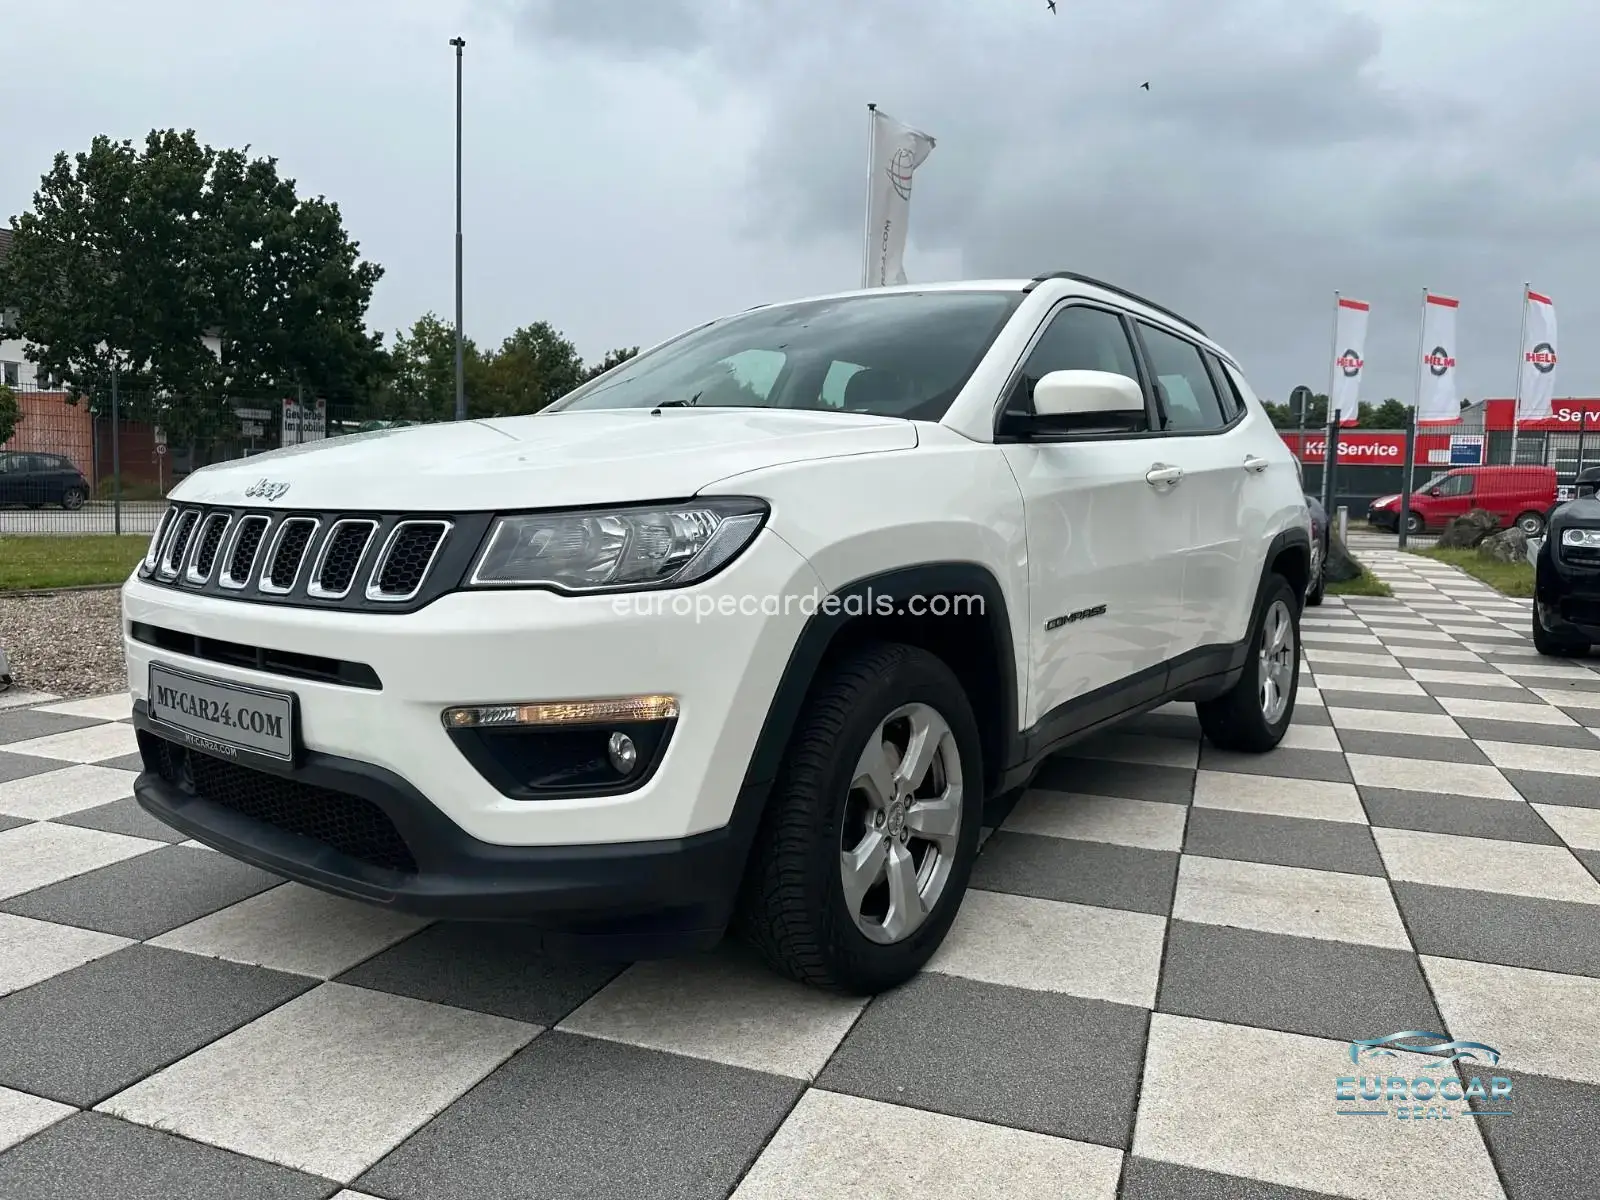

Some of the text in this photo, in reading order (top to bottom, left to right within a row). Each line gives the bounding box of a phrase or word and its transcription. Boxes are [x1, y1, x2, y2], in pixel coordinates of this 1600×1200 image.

[1424, 355, 1456, 368] HELM
[1305, 441, 1398, 456] Kf Service
[244, 477, 291, 502] Jeep
[1044, 604, 1107, 631] COMPASS
[156, 684, 284, 739] MY-CAR24.COM
[184, 733, 238, 757] MY-CAR24.COM
